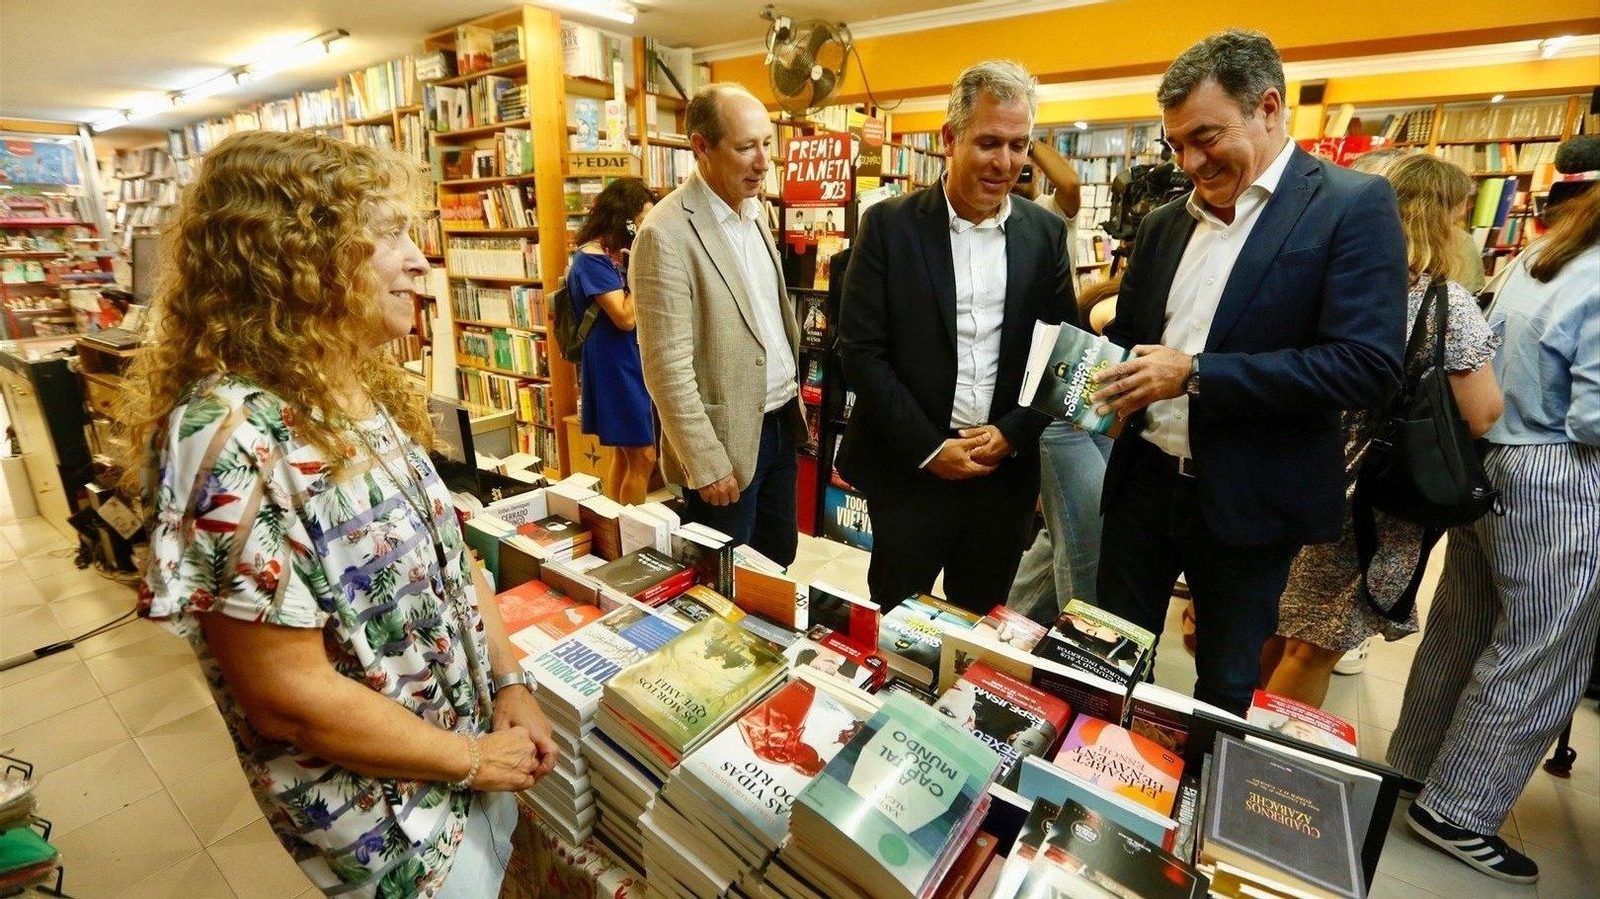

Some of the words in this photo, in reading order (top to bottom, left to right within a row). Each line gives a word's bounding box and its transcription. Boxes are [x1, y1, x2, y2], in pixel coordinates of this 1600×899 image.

[586, 156, 628, 168] EDAF
[786, 159, 850, 182] PLANETA
[1064, 362, 1086, 406] CUANDO
[1082, 347, 1093, 362] LA
[1065, 366, 1092, 418] TORMENTA
[502, 508, 528, 522] CERRADO
[845, 494, 868, 513] TODO
[534, 652, 578, 684] PADILLA
[1057, 646, 1098, 668] INCIERTOS
[1060, 652, 1076, 662] SUS
[1083, 662, 1115, 683] CIUDAD
[1099, 666, 1128, 684] MUROS
[573, 677, 602, 697] PAZ
[637, 676, 682, 714] MORTOS
[656, 678, 686, 700] AMEI
[682, 695, 708, 719] QUE
[682, 710, 698, 725] OS
[974, 686, 1046, 726] ESPEJISMO
[893, 730, 958, 780] MUNDO
[1099, 746, 1145, 770] ESNOB
[720, 761, 764, 800] VIDAS
[879, 746, 944, 798] CAPTAL
[1073, 746, 1164, 793] BENAVENT
[765, 797, 789, 816] AS
[773, 786, 796, 806] DO
[1246, 800, 1320, 838] CUADERNOS
[1249, 792, 1312, 824] AZABACHE
